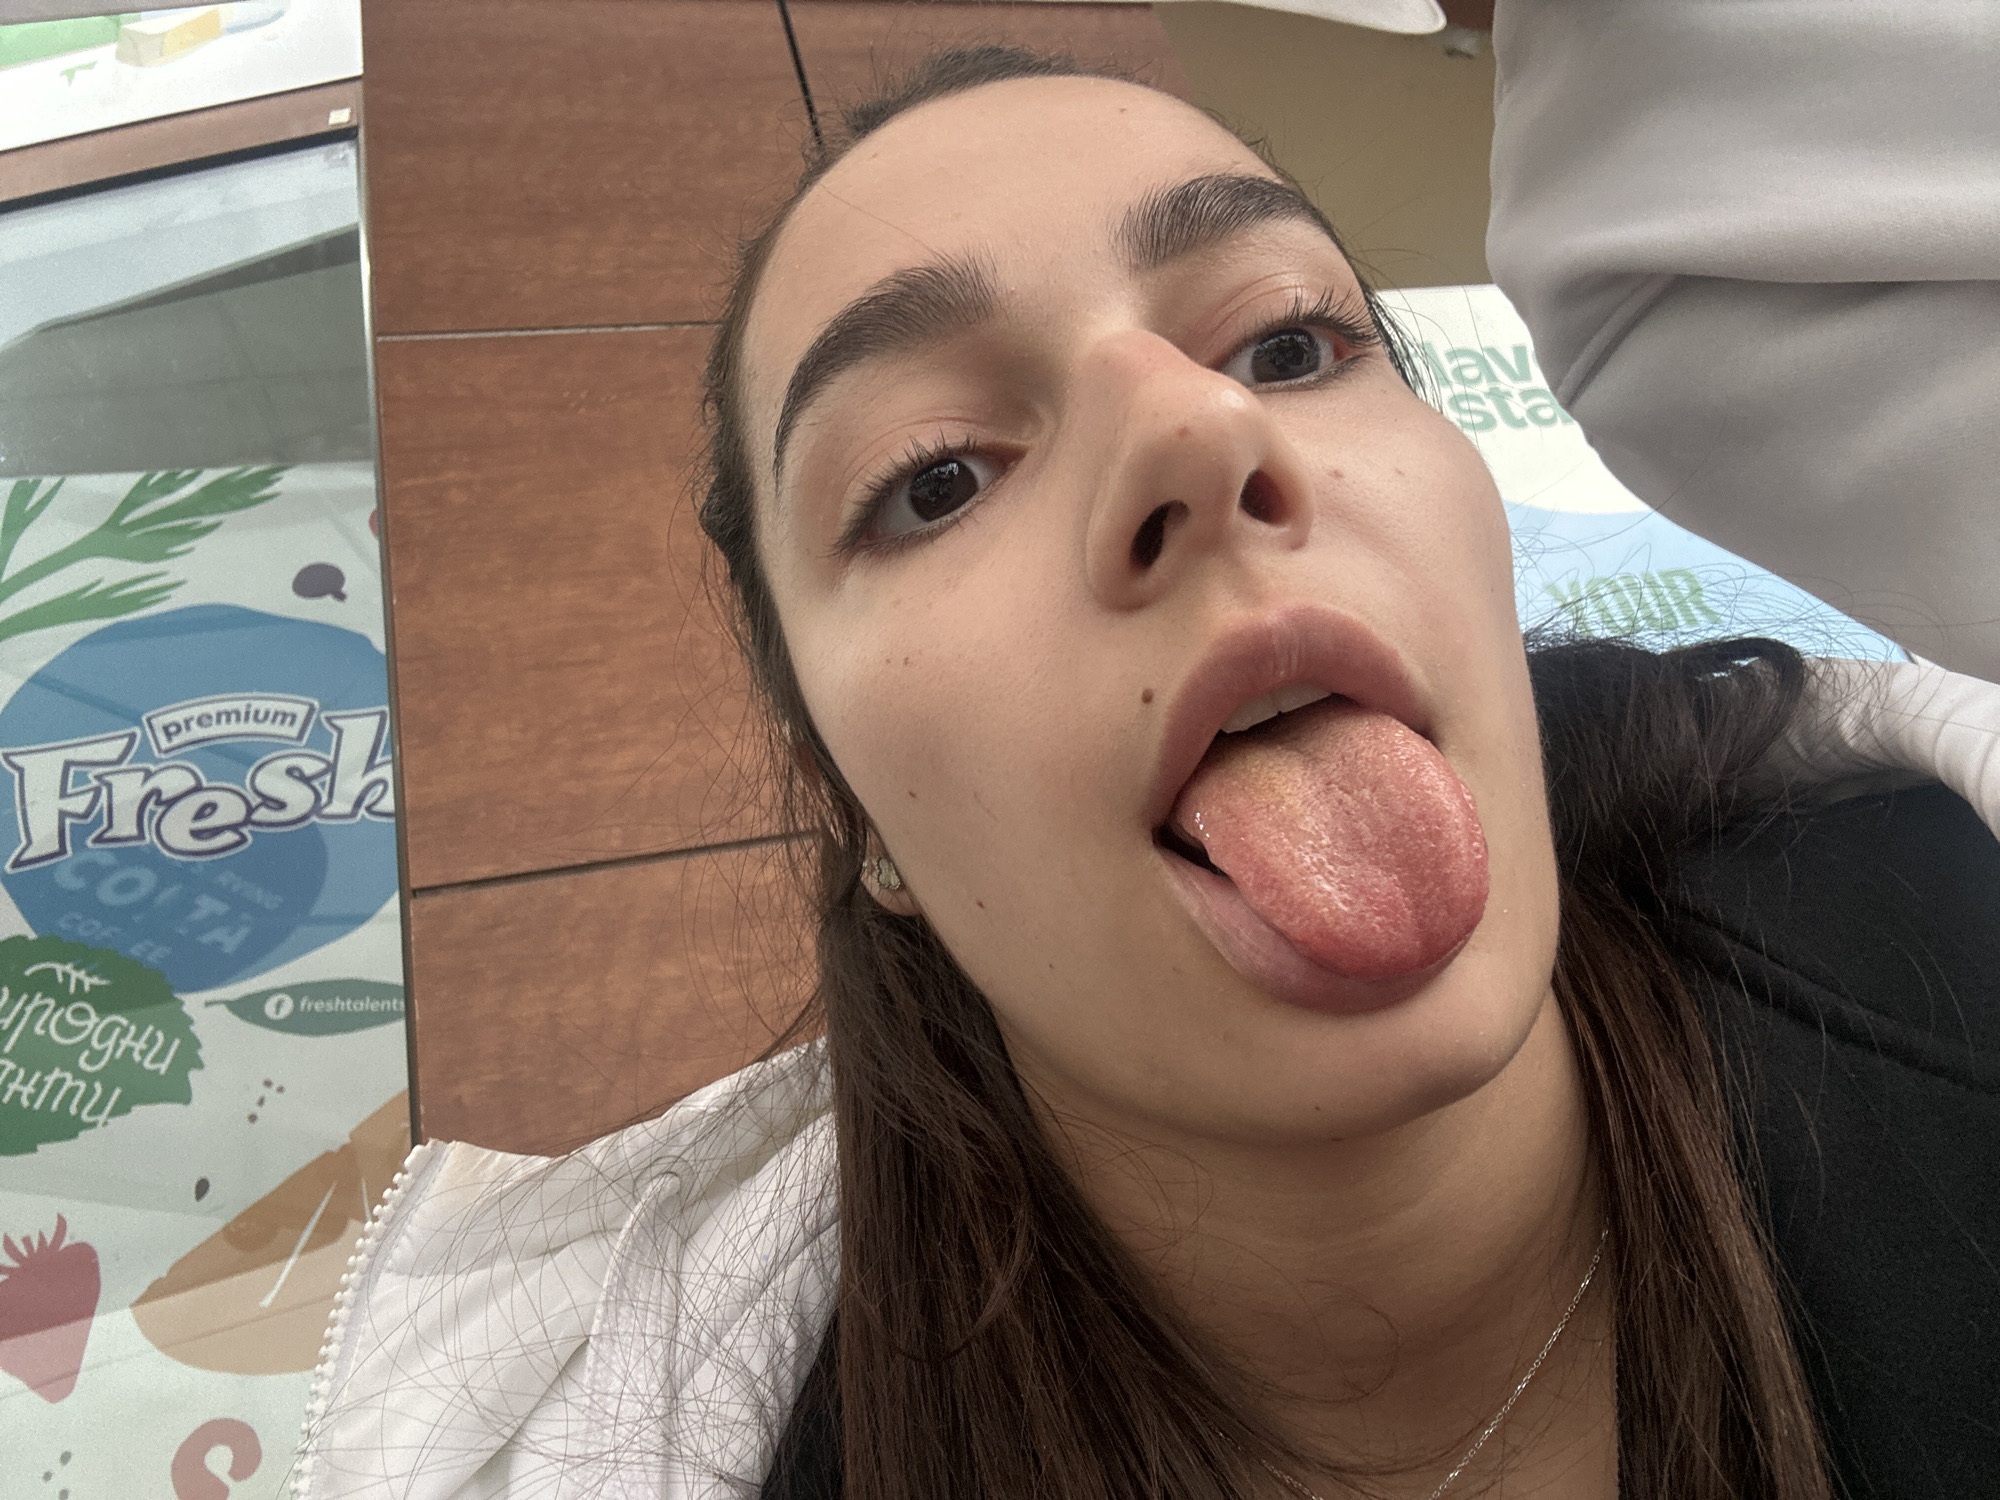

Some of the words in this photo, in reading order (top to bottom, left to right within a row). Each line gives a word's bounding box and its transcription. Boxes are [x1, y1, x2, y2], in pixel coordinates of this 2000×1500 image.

[1406, 341, 1537, 387] lav
[1544, 568, 1722, 638] YOUR
[162, 703, 297, 741] premium
[2, 708, 396, 870] Fresh
